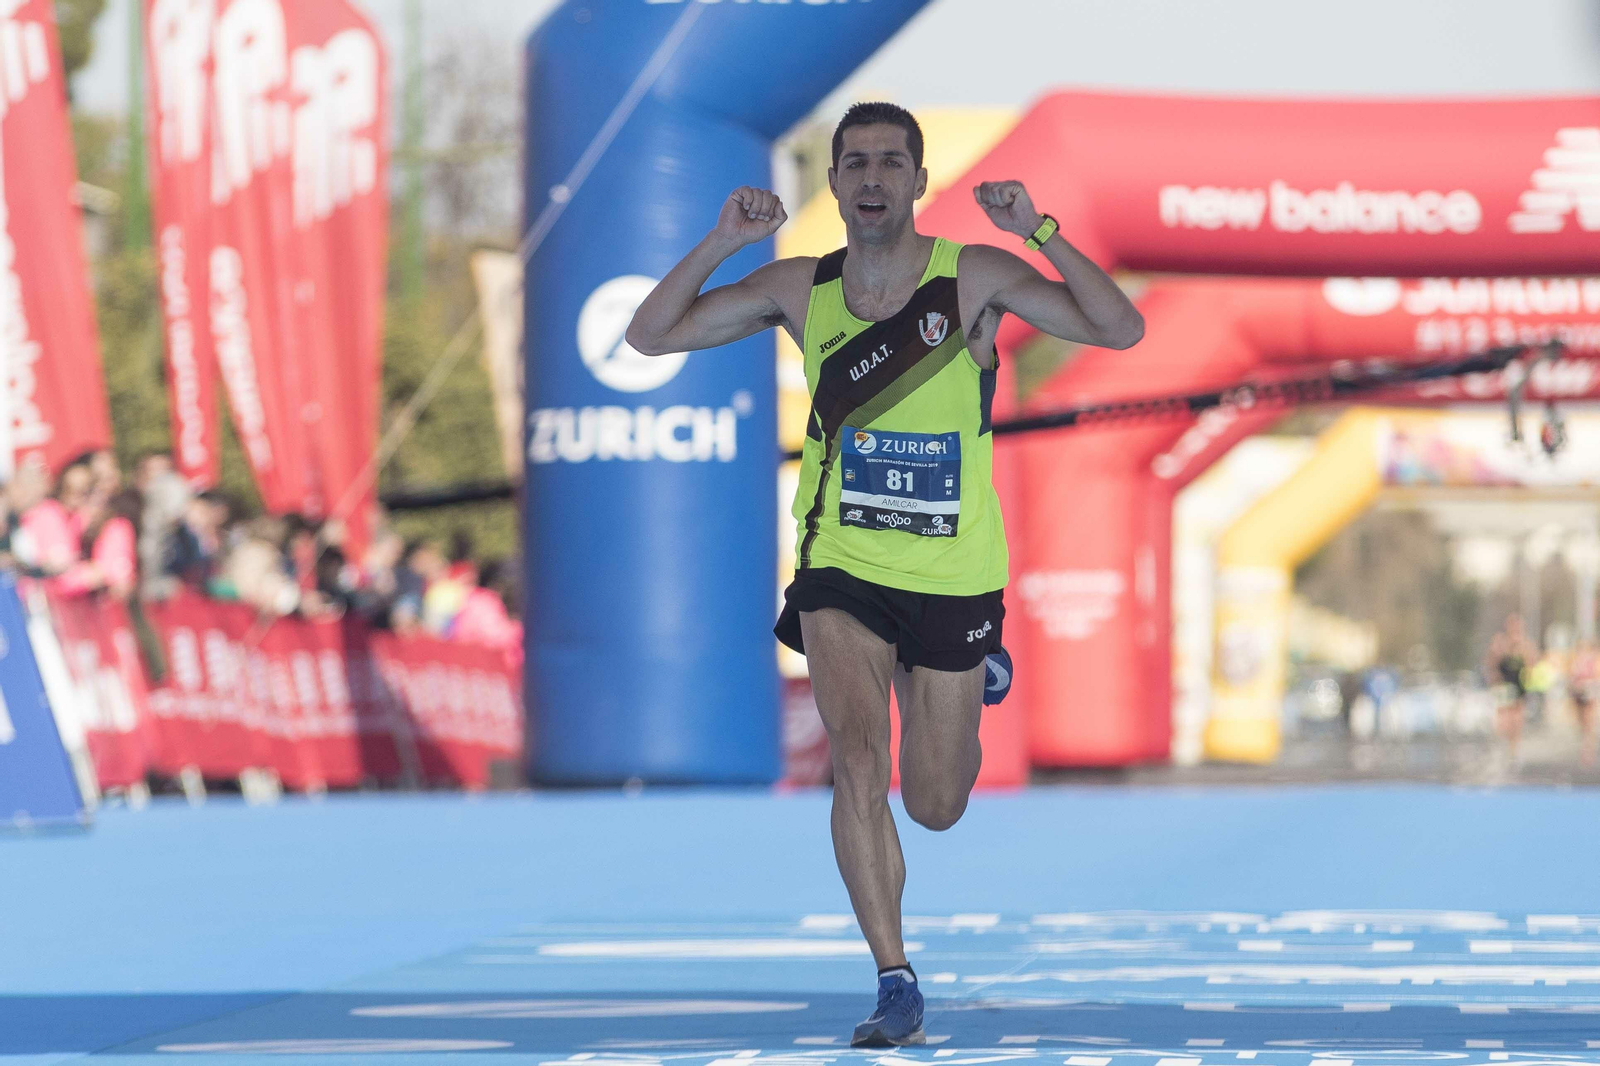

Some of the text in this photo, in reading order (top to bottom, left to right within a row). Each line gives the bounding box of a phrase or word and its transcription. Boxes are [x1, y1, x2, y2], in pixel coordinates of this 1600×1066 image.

[1159, 179, 1482, 234] new balance
[819, 331, 847, 353] Joma
[850, 344, 893, 382] U.D.A.T.
[528, 405, 737, 463] ZURICH
[881, 439, 948, 455] ZURICH
[886, 468, 914, 492] 81
[881, 498, 918, 509] AMILCAR
